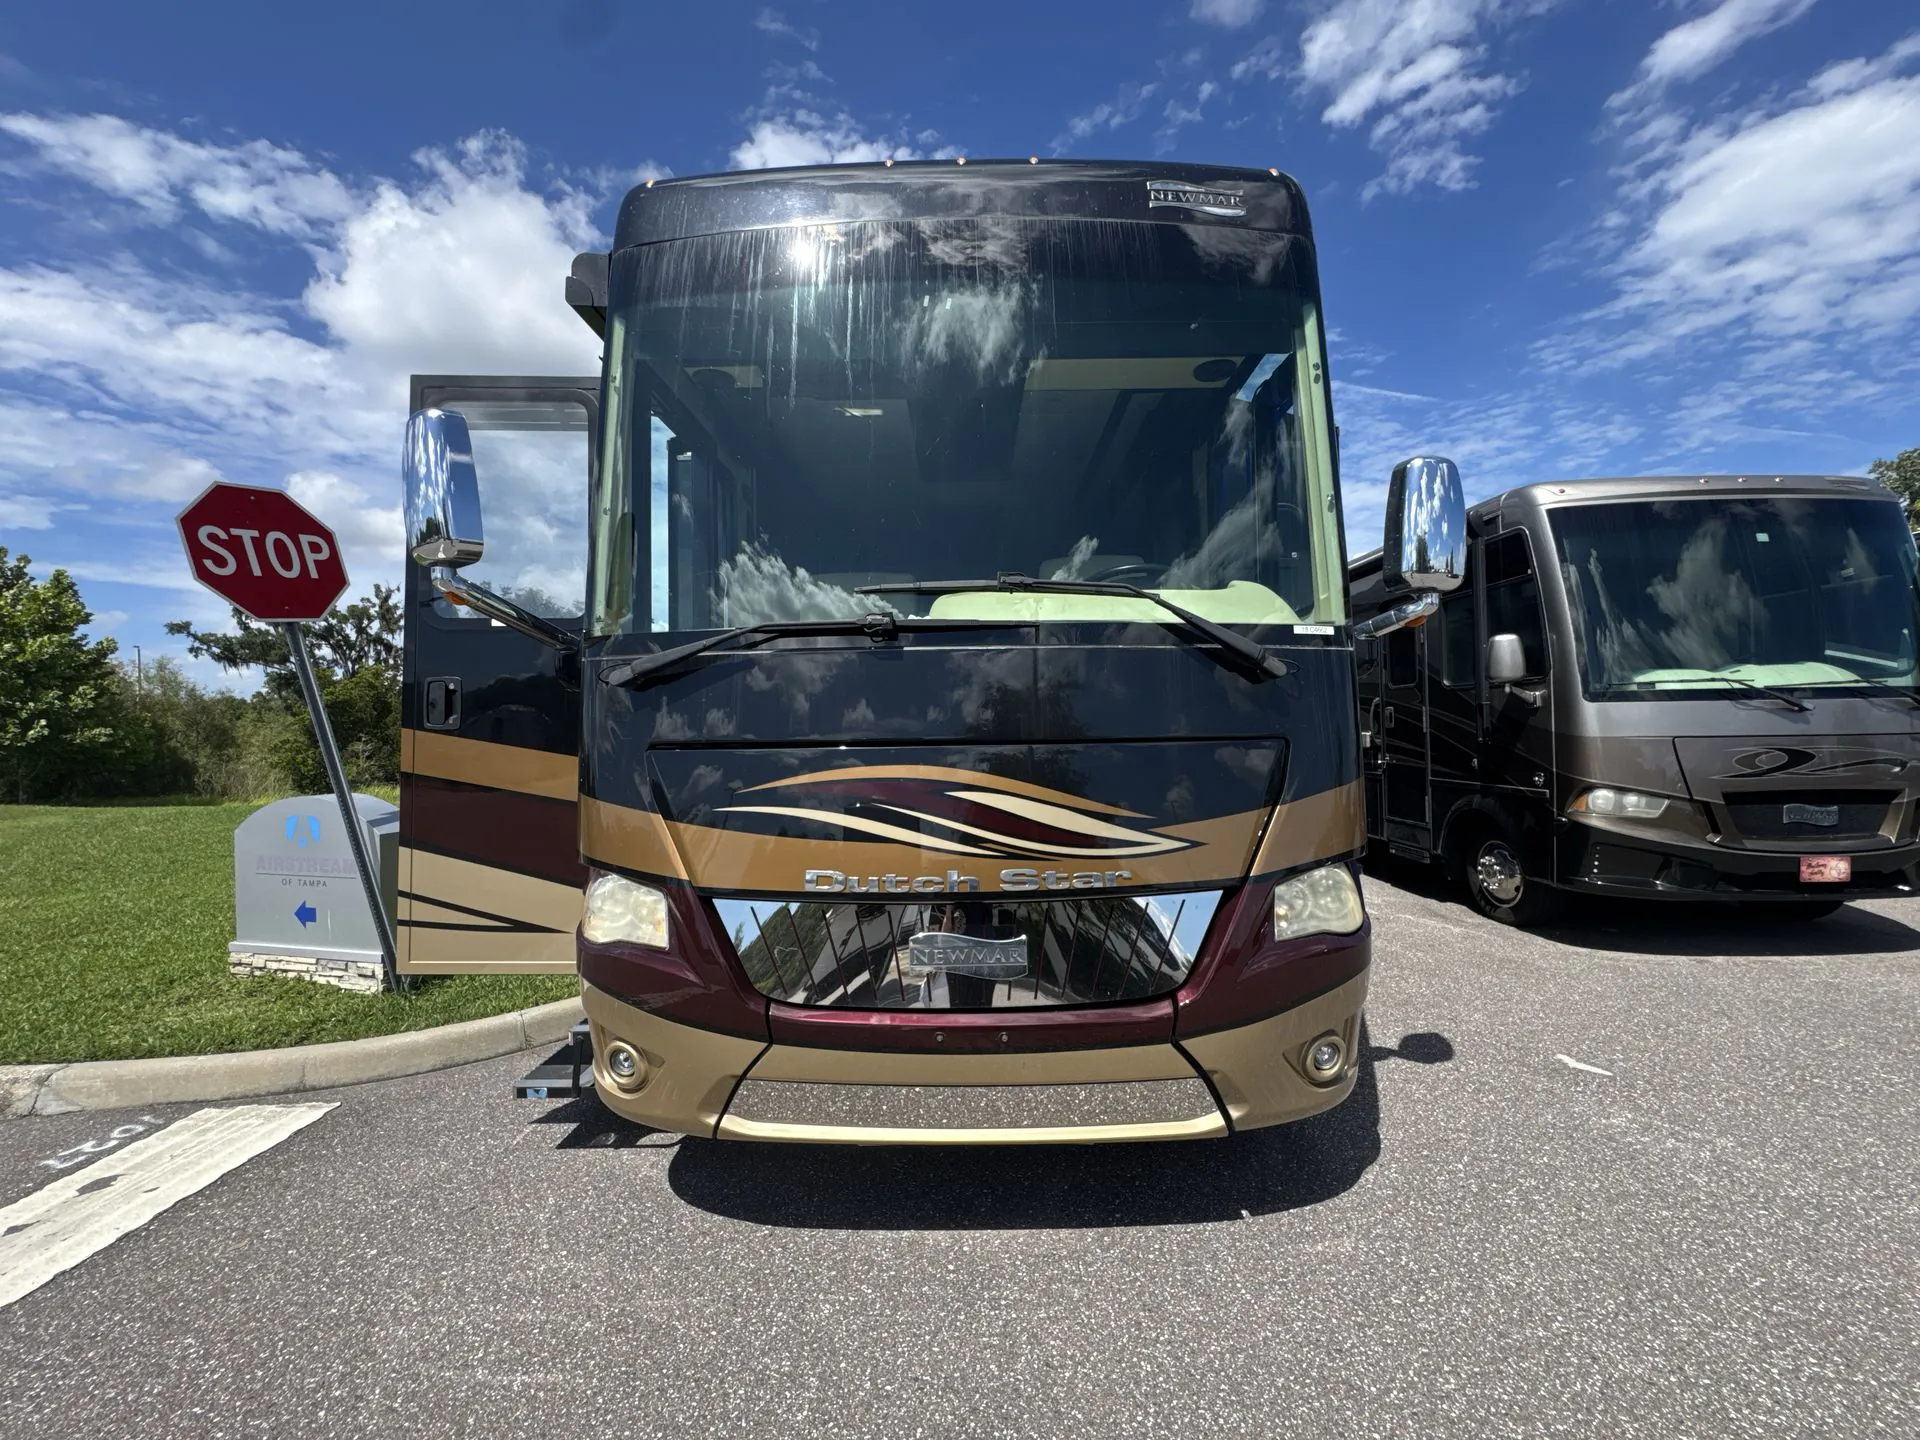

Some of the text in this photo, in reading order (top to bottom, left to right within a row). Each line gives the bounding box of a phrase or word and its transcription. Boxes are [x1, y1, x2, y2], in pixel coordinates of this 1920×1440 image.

[1150, 190, 1243, 206] NEWMAR
[197, 525, 331, 579] STOP
[256, 855, 358, 874] AIRSTREAM
[281, 878, 328, 888] OF TAMPA
[804, 868, 1133, 893] Dutch Star
[911, 948, 1026, 965] NEWMAR
